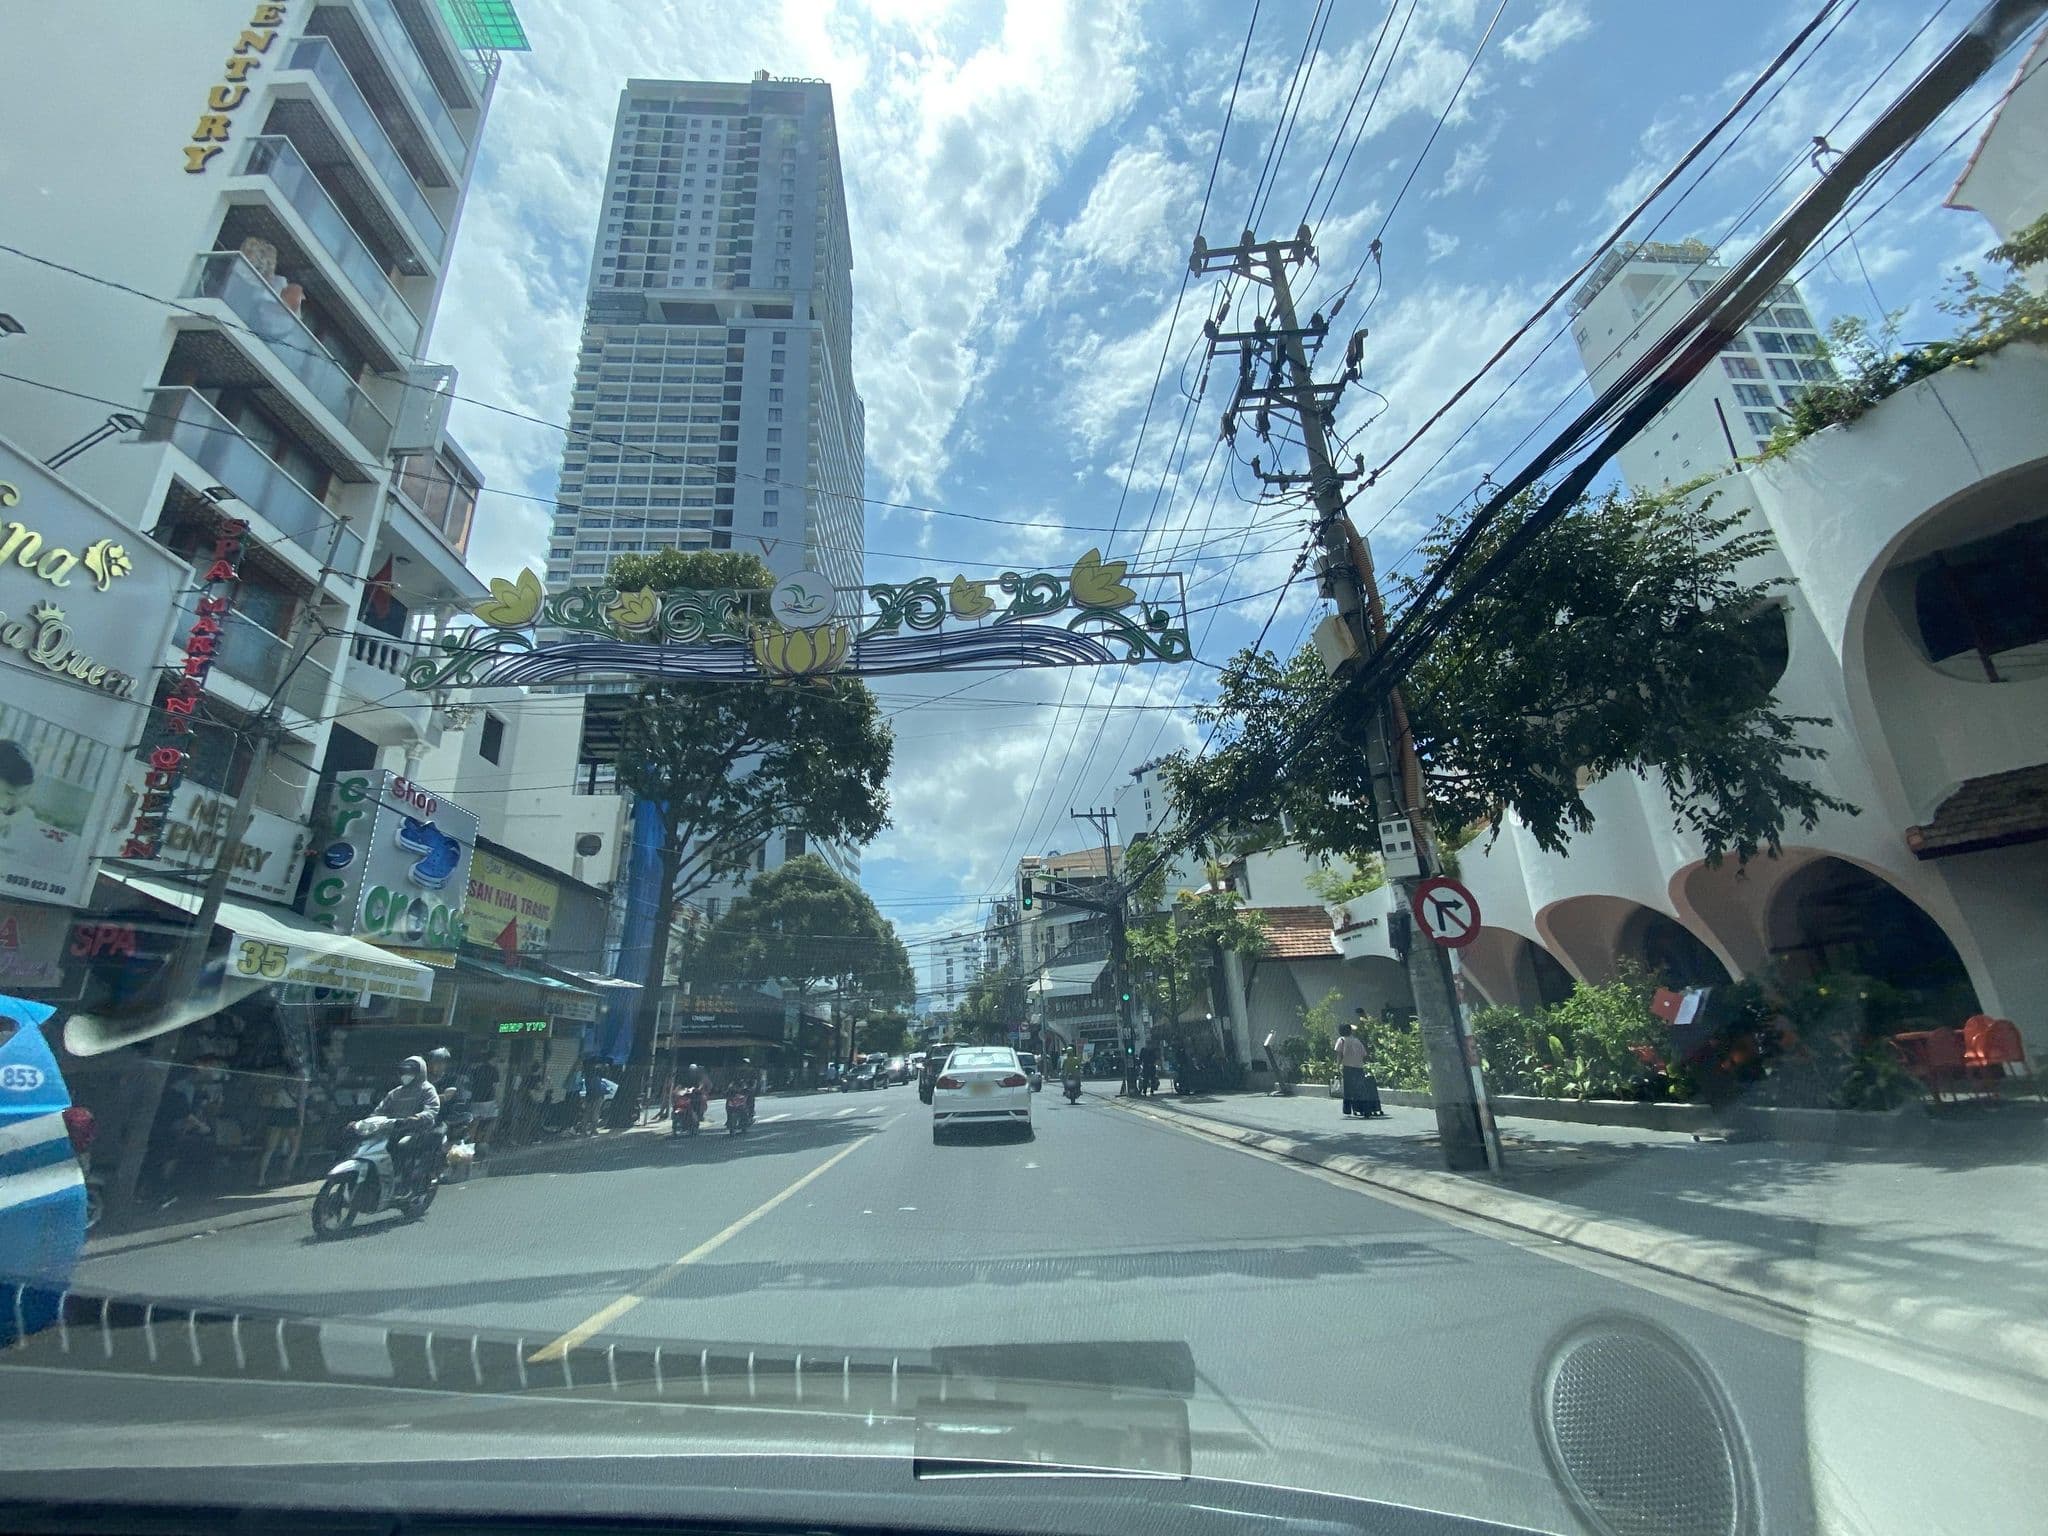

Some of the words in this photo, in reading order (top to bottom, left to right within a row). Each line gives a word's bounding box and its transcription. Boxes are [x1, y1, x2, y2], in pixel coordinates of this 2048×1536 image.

[182, 0, 289, 174] ENTURY
[28, 617, 138, 699] Queen
[391, 776, 437, 817] Shop
[70, 922, 136, 957] SPA
[237, 940, 289, 979] 35
[4, 1067, 38, 1088] 853
